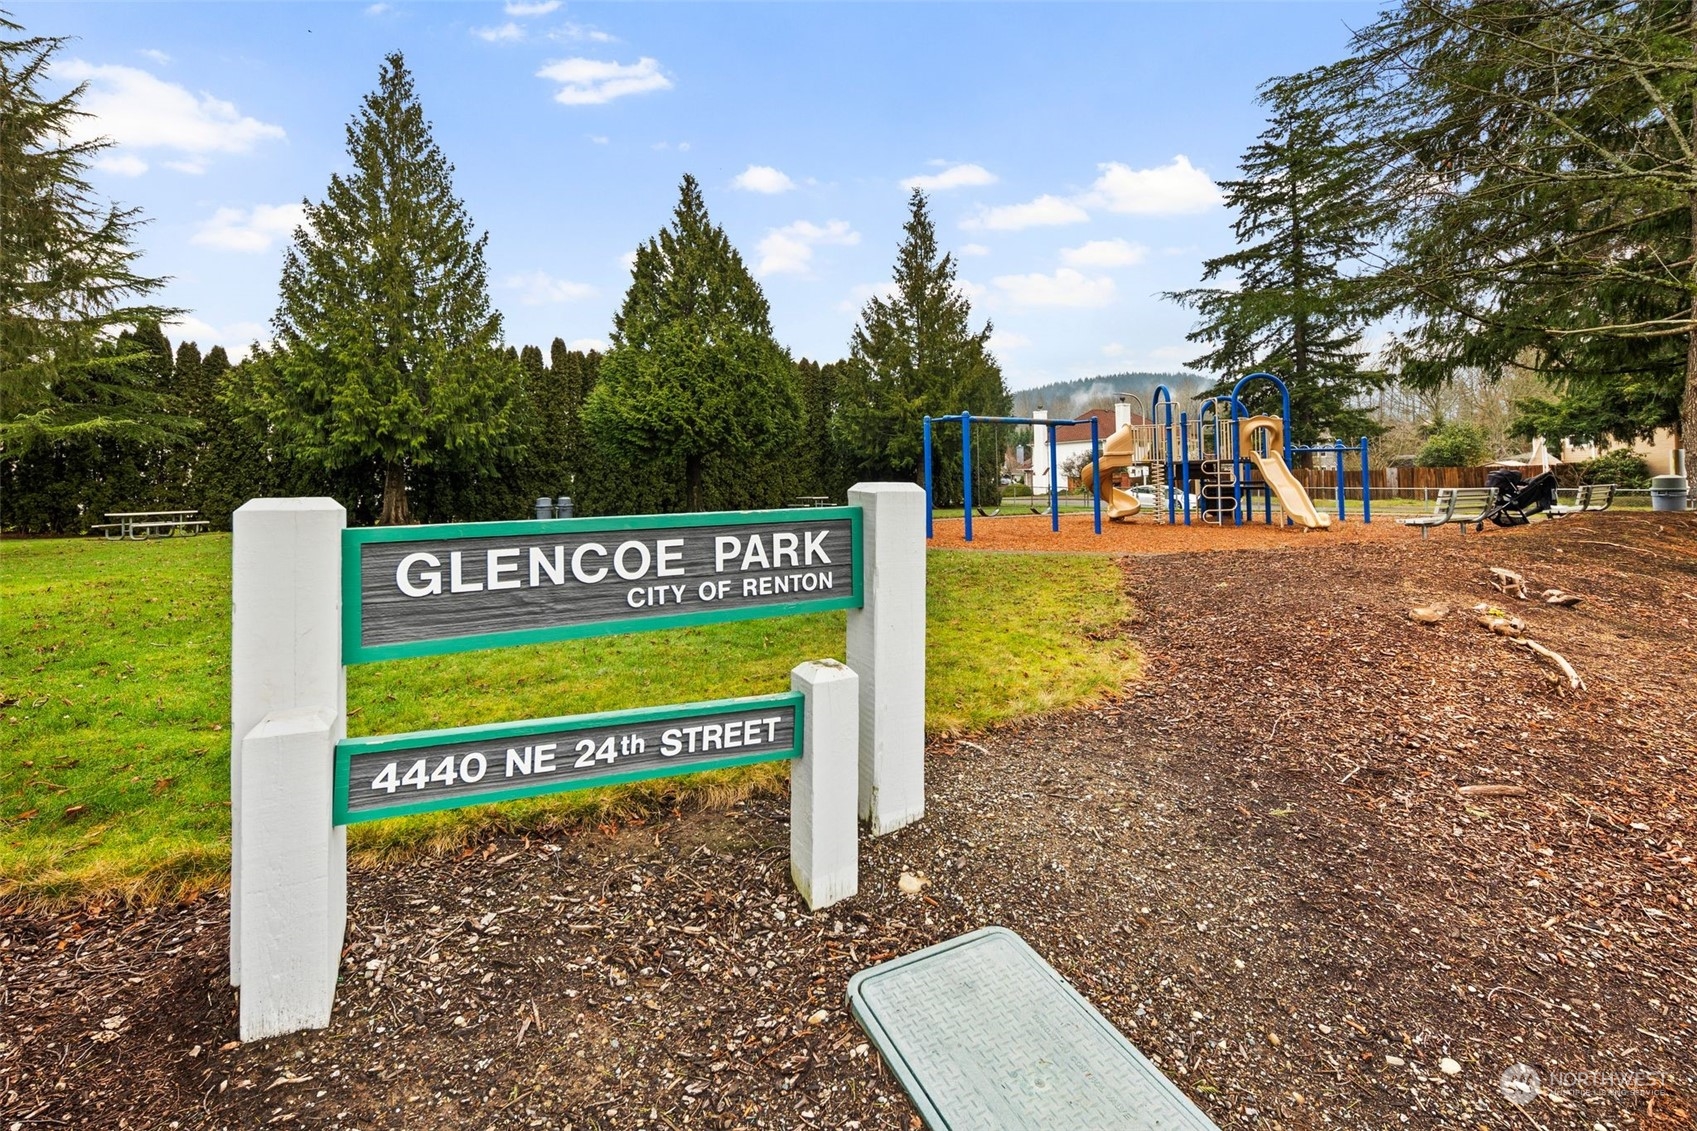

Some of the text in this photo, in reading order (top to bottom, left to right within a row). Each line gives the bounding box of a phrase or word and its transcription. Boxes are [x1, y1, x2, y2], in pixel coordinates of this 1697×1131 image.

[396, 530, 832, 597] GLENCOE PARK
[627, 571, 833, 608] CITY OF RENTON
[371, 716, 782, 794] 4440 NE 24th STREET
